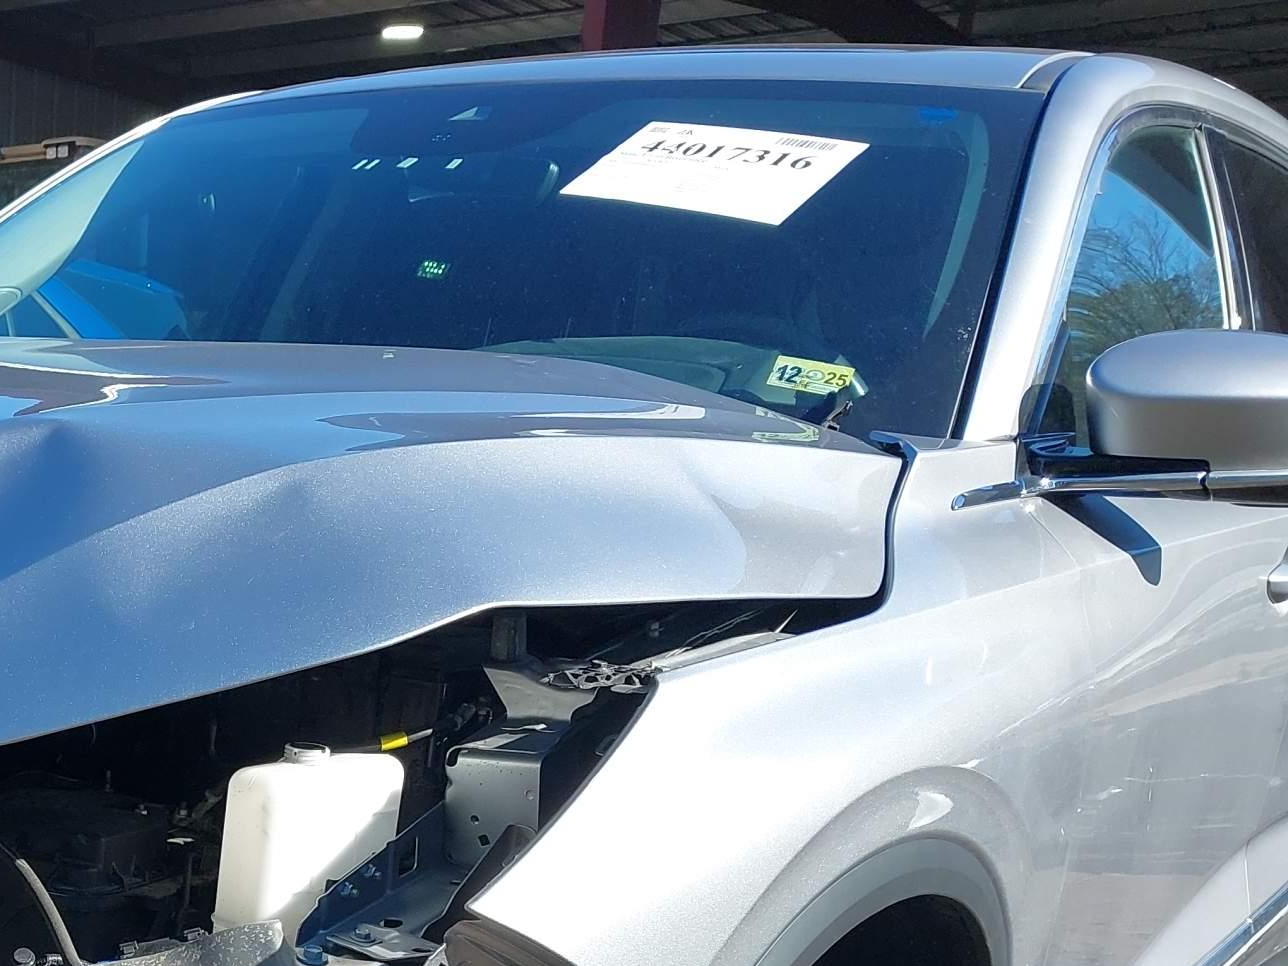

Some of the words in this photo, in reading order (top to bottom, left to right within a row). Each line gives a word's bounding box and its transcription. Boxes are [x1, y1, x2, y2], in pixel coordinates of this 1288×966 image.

[641, 139, 816, 170] 44017316
[776, 364, 802, 384] 12
[824, 372, 848, 387] 25
